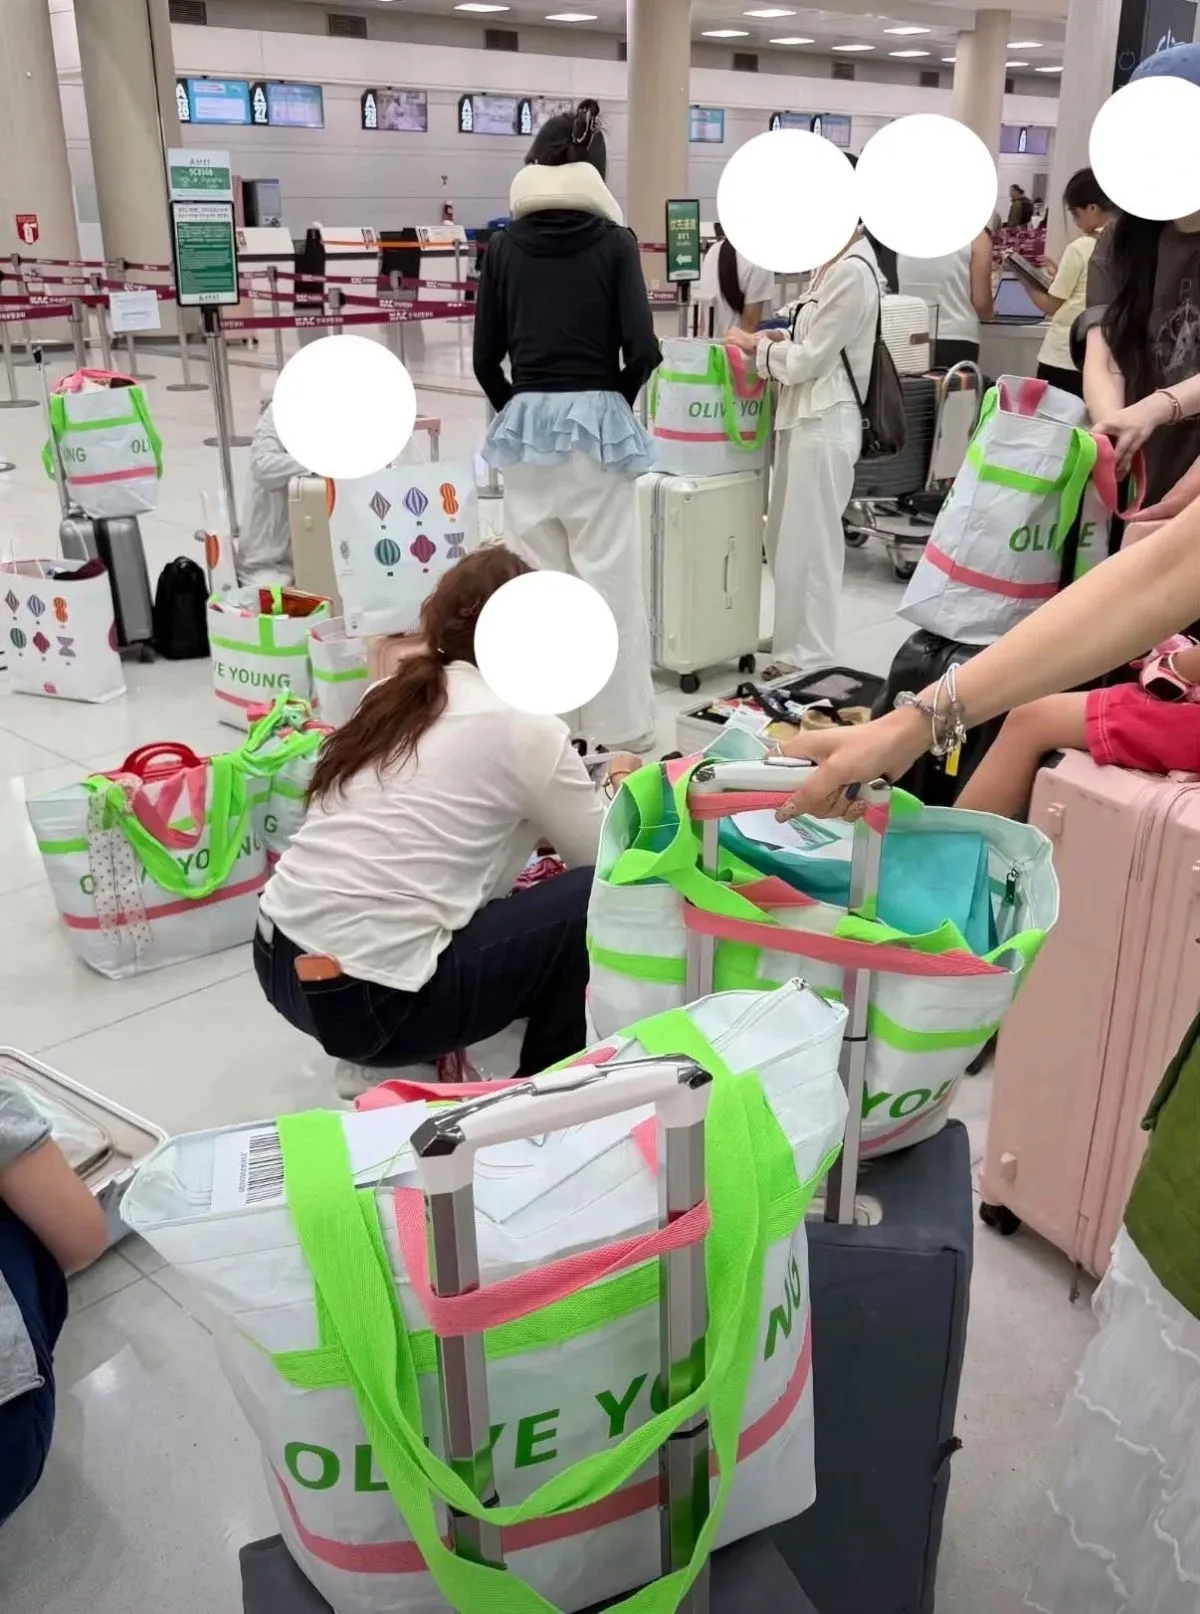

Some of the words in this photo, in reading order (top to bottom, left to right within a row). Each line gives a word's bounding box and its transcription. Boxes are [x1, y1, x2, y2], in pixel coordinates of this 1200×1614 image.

[253, 87, 267, 102] A
[688, 402, 737, 418] OLIV
[1009, 521, 1096, 553] OLIE
[229, 666, 291, 688] YOUNG
